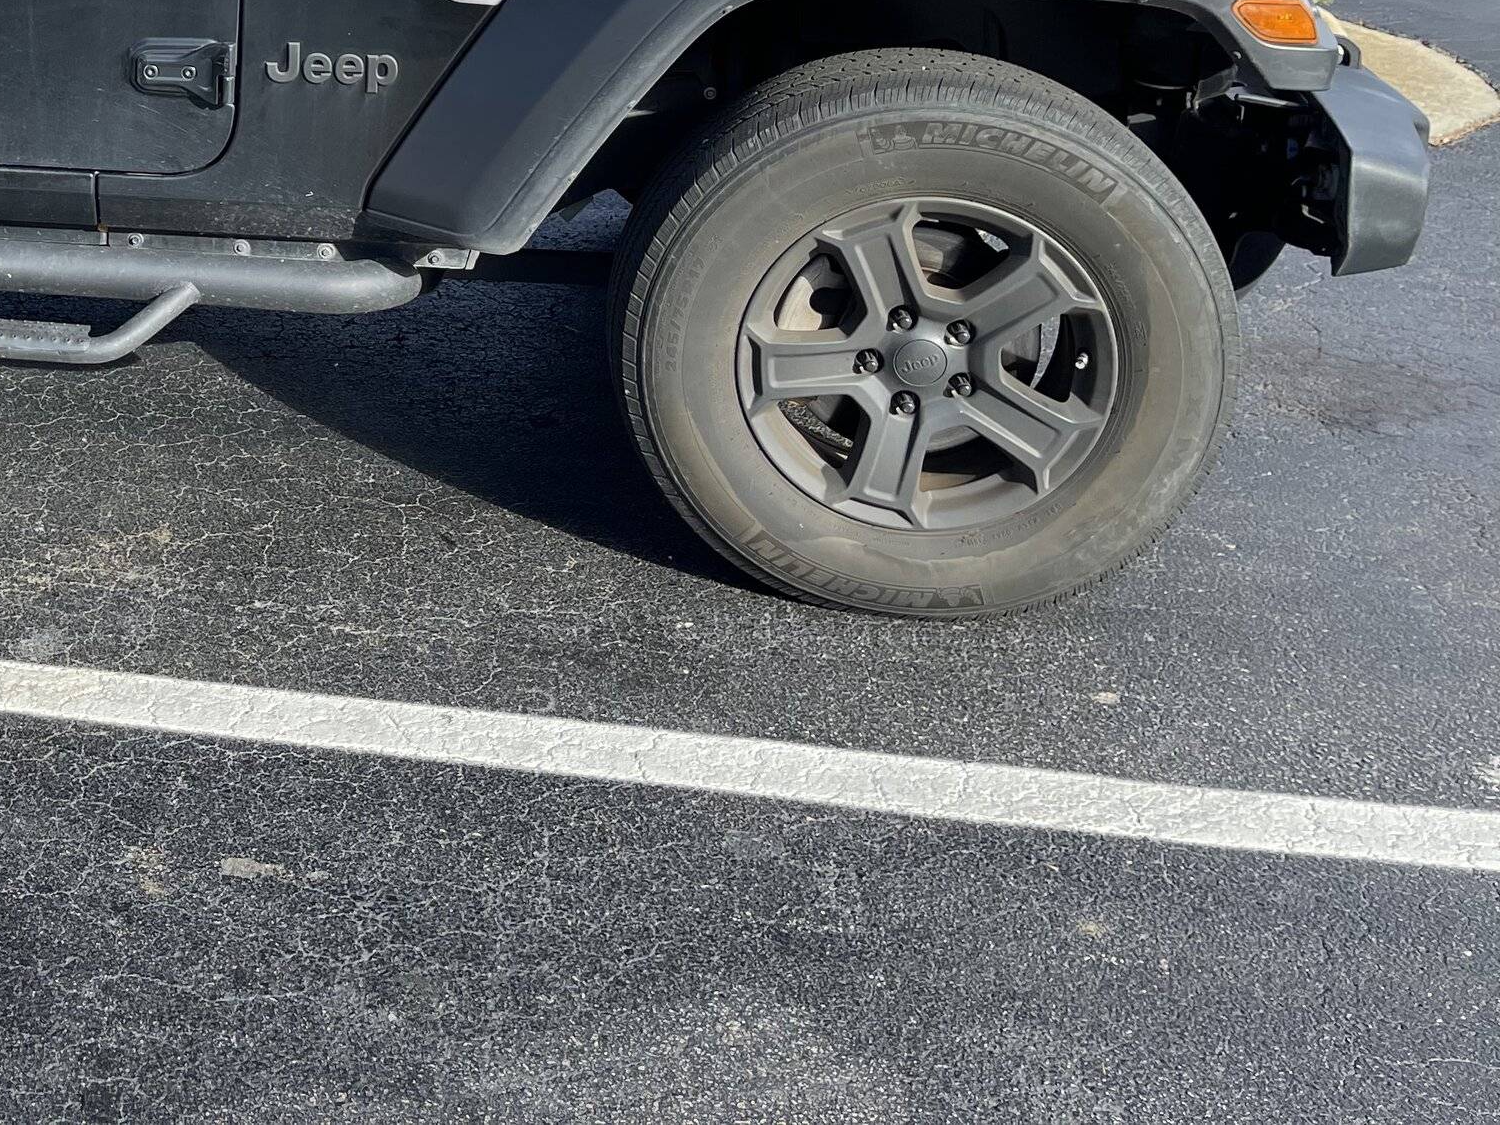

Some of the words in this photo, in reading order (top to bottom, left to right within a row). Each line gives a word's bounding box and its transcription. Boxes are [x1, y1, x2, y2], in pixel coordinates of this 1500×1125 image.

[266, 41, 399, 94] Jeep
[921, 122, 1118, 197] MICHELIN
[900, 354, 938, 373] Jeep
[753, 539, 934, 607] MICHELIN
